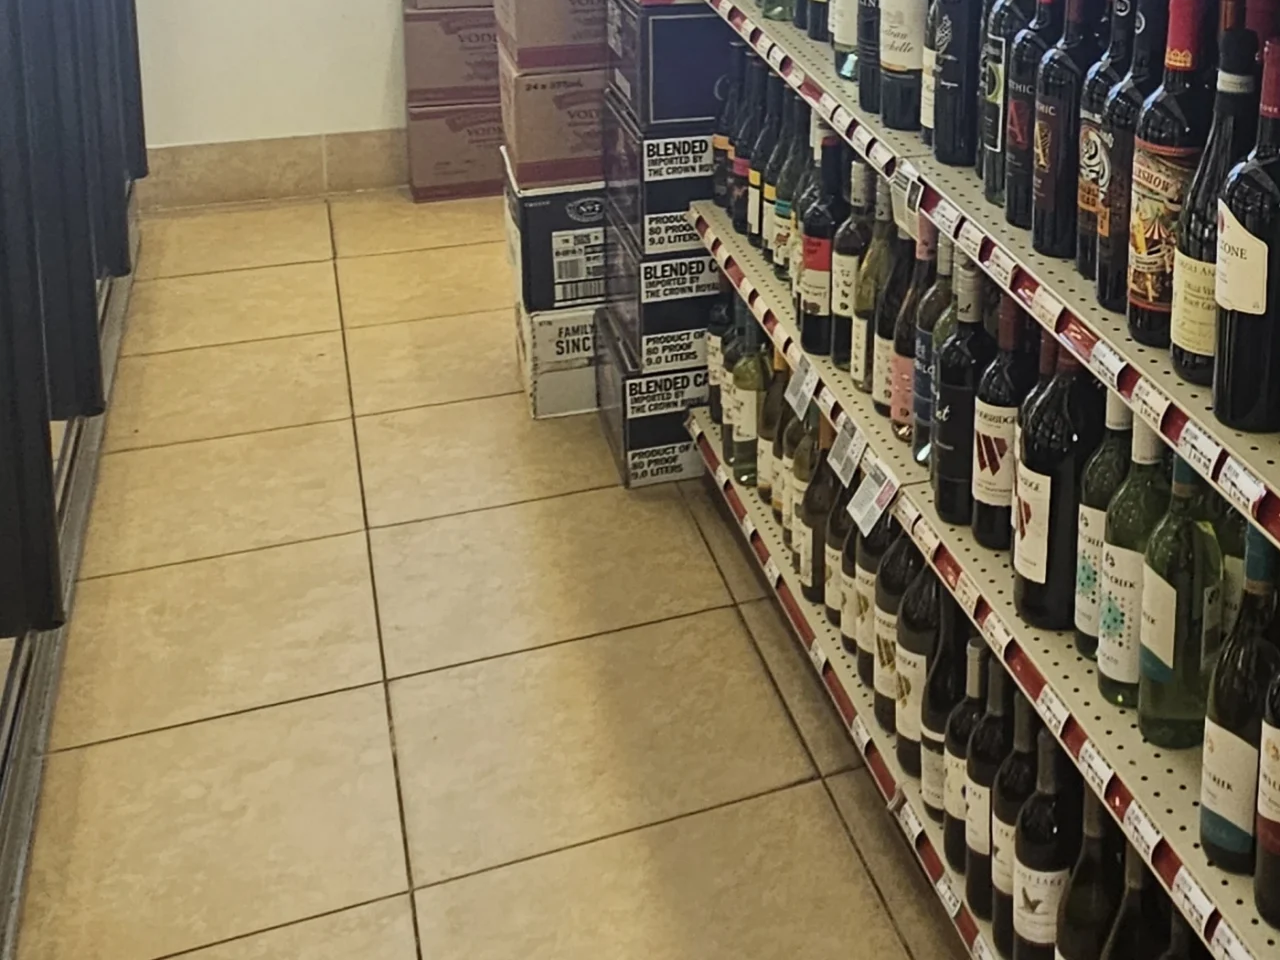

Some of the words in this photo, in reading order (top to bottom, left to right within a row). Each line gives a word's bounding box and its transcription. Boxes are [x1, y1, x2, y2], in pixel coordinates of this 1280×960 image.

[647, 139, 708, 158] BLENDED
[648, 167, 664, 176] THE
[649, 227, 661, 235] 80
[649, 236, 665, 246] 9.0
[644, 260, 705, 280] BLENDED
[646, 289, 661, 298] THE
[646, 332, 691, 345] PRODUCT
[556, 337, 592, 355] SINC
[646, 346, 659, 355] 80
[662, 341, 693, 353] PROOF
[646, 356, 662, 366] 9.0
[665, 351, 698, 363] LITERS
[629, 375, 690, 396] BLENDED
[630, 404, 646, 414] THE
[631, 446, 676, 460] PRODUCT
[679, 443, 690, 452] OF
[647, 455, 678, 467] PROOF
[651, 464, 683, 476] LITERS
